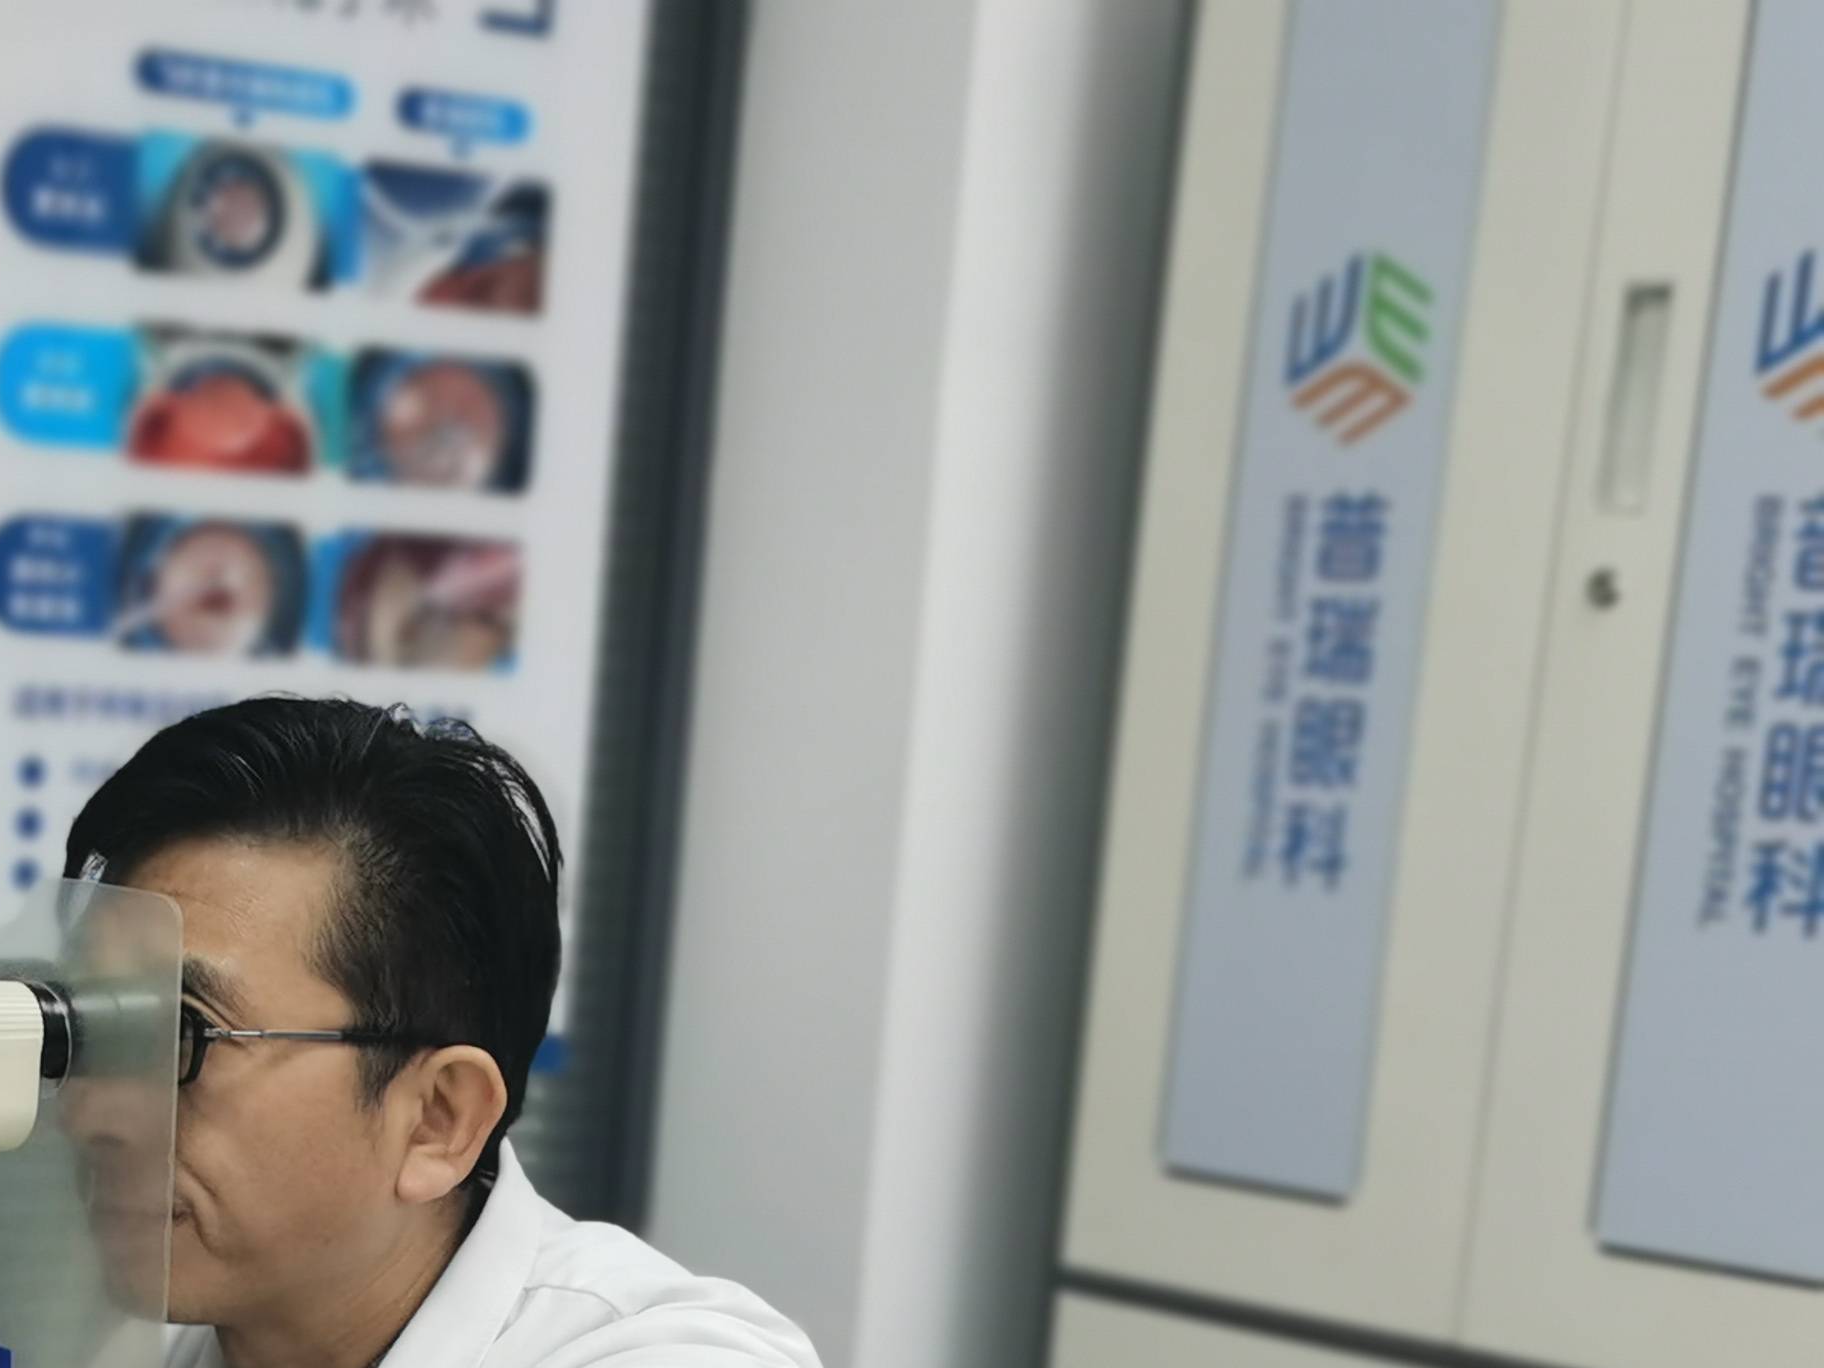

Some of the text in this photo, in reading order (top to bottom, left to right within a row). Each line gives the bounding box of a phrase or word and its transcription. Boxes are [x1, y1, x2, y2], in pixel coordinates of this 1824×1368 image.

[1697, 493, 1783, 930] BRIGHT EYE HOSPITAL
